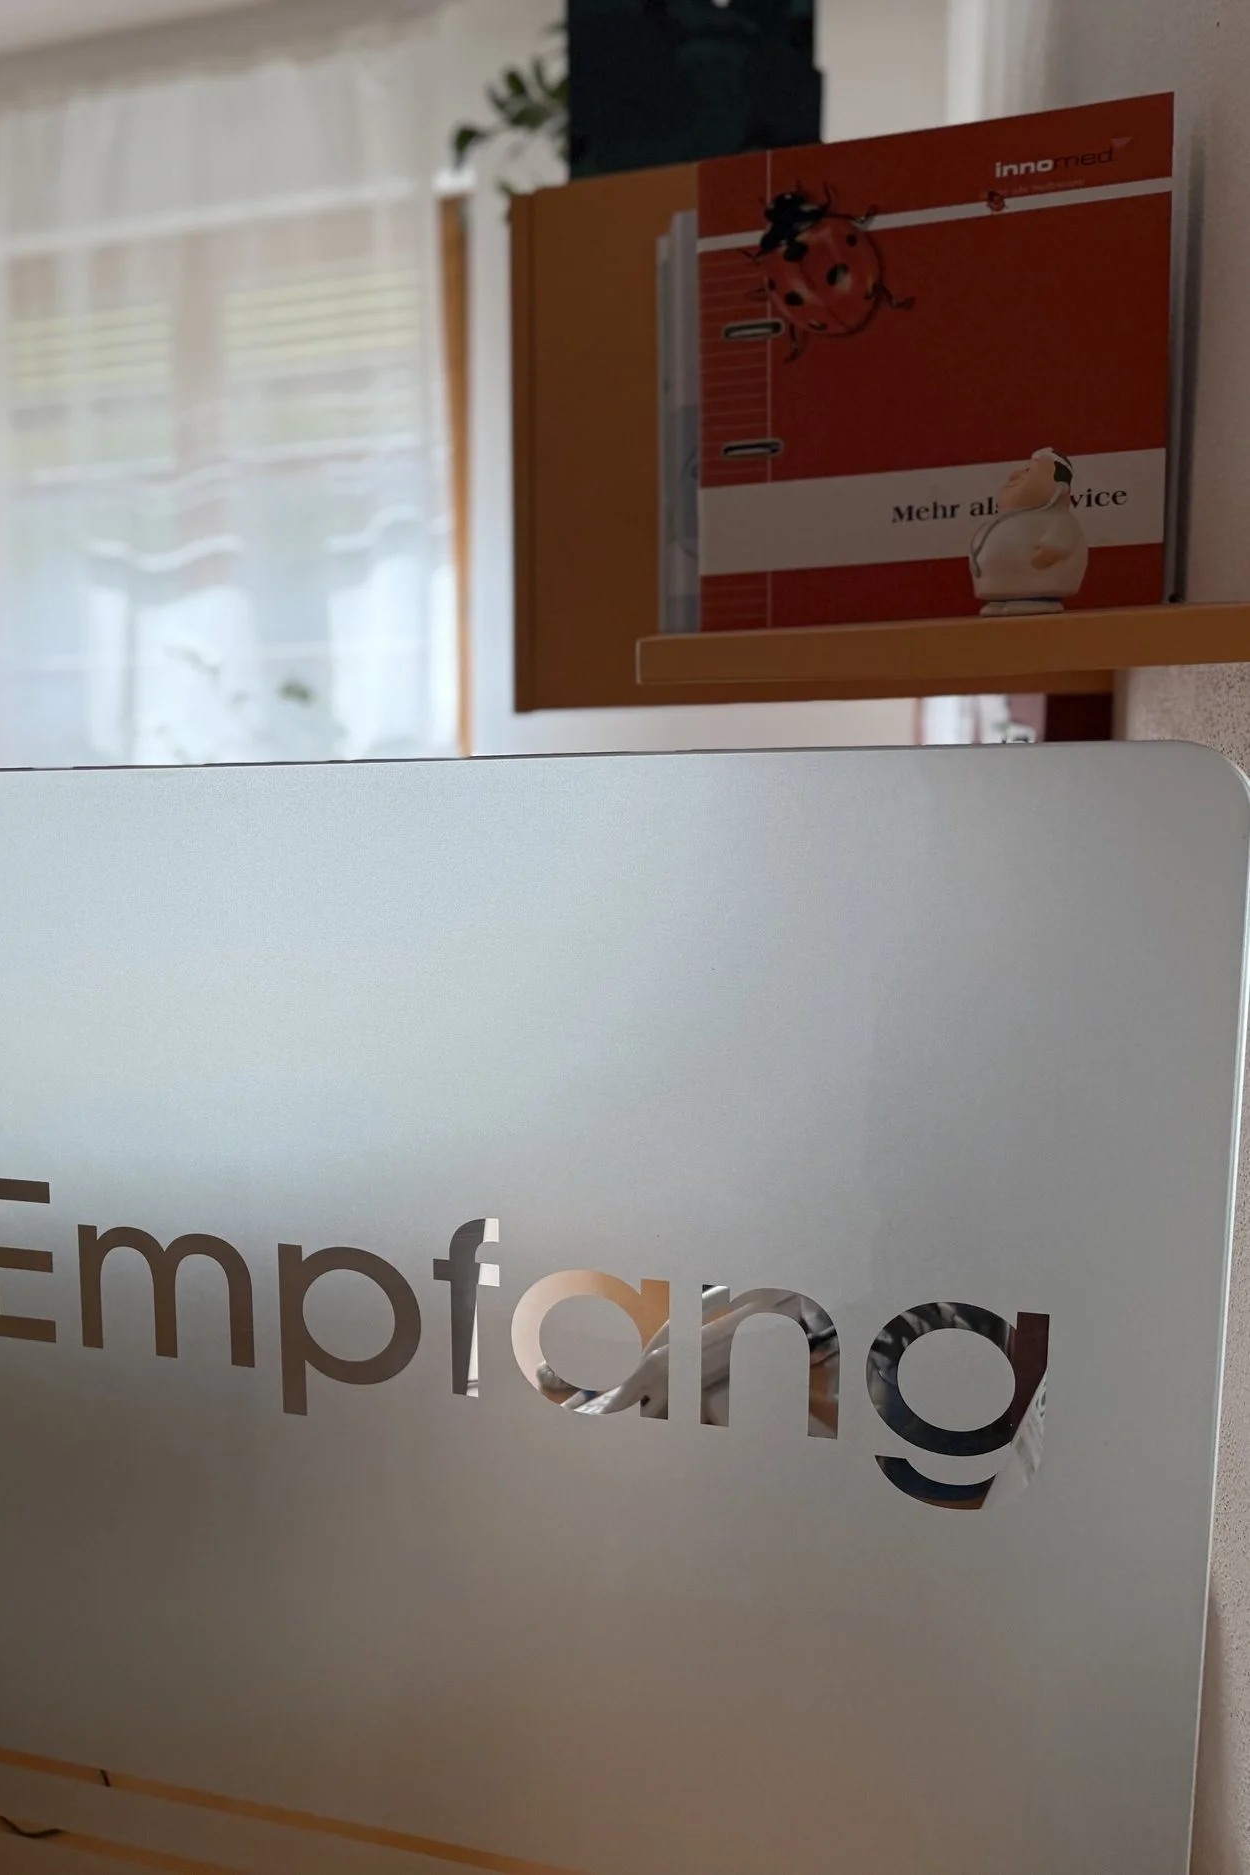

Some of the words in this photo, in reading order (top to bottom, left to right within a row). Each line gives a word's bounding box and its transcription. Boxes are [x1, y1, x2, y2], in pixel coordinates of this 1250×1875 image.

[994, 146, 1114, 179] innomed
[892, 501, 960, 524] Mehr
[1070, 488, 1128, 509] vice
